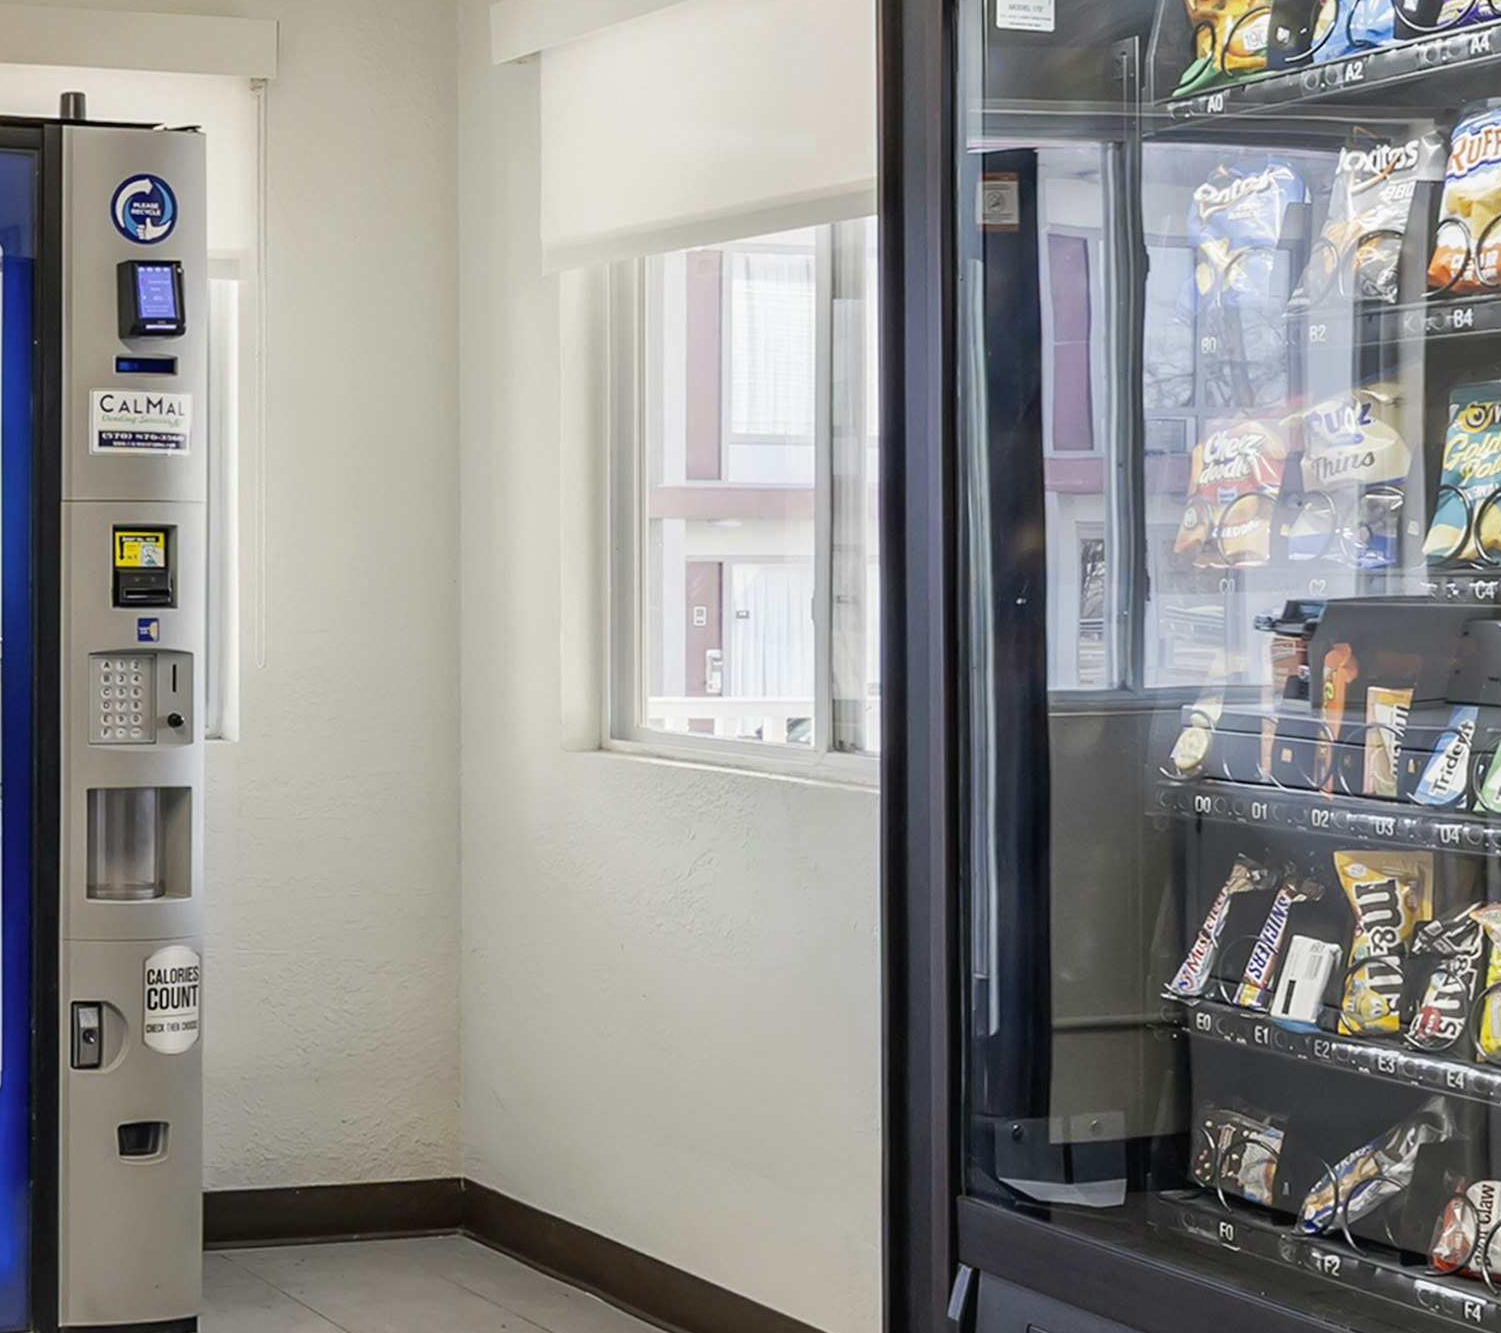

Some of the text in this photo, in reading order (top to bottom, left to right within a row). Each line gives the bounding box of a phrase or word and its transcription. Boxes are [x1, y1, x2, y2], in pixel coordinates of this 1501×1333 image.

[1470, 35, 1491, 55] A4
[1345, 62, 1365, 83] A2
[1207, 95, 1225, 113] A0
[1453, 309, 1474, 329] B4
[1309, 324, 1326, 343] B2
[1201, 336, 1217, 354] B0
[1218, 578, 1236, 596] C0
[1308, 578, 1327, 597] C2
[1474, 580, 1496, 600] C4
[1194, 796, 1212, 814] D0
[1252, 802, 1268, 819] D1
[1311, 810, 1329, 828] D2
[147, 966, 200, 986] CALORIES
[147, 985, 199, 1011] COUNT
[1196, 1013, 1212, 1031] E0
[1254, 1026, 1269, 1044] E1
[1314, 1039, 1330, 1059] E2
[1378, 1054, 1396, 1074] E3
[1446, 1070, 1465, 1089] E4
[1219, 1221, 1234, 1242] F0
[1323, 1256, 1341, 1277] F2
[1464, 1300, 1482, 1323] F4
